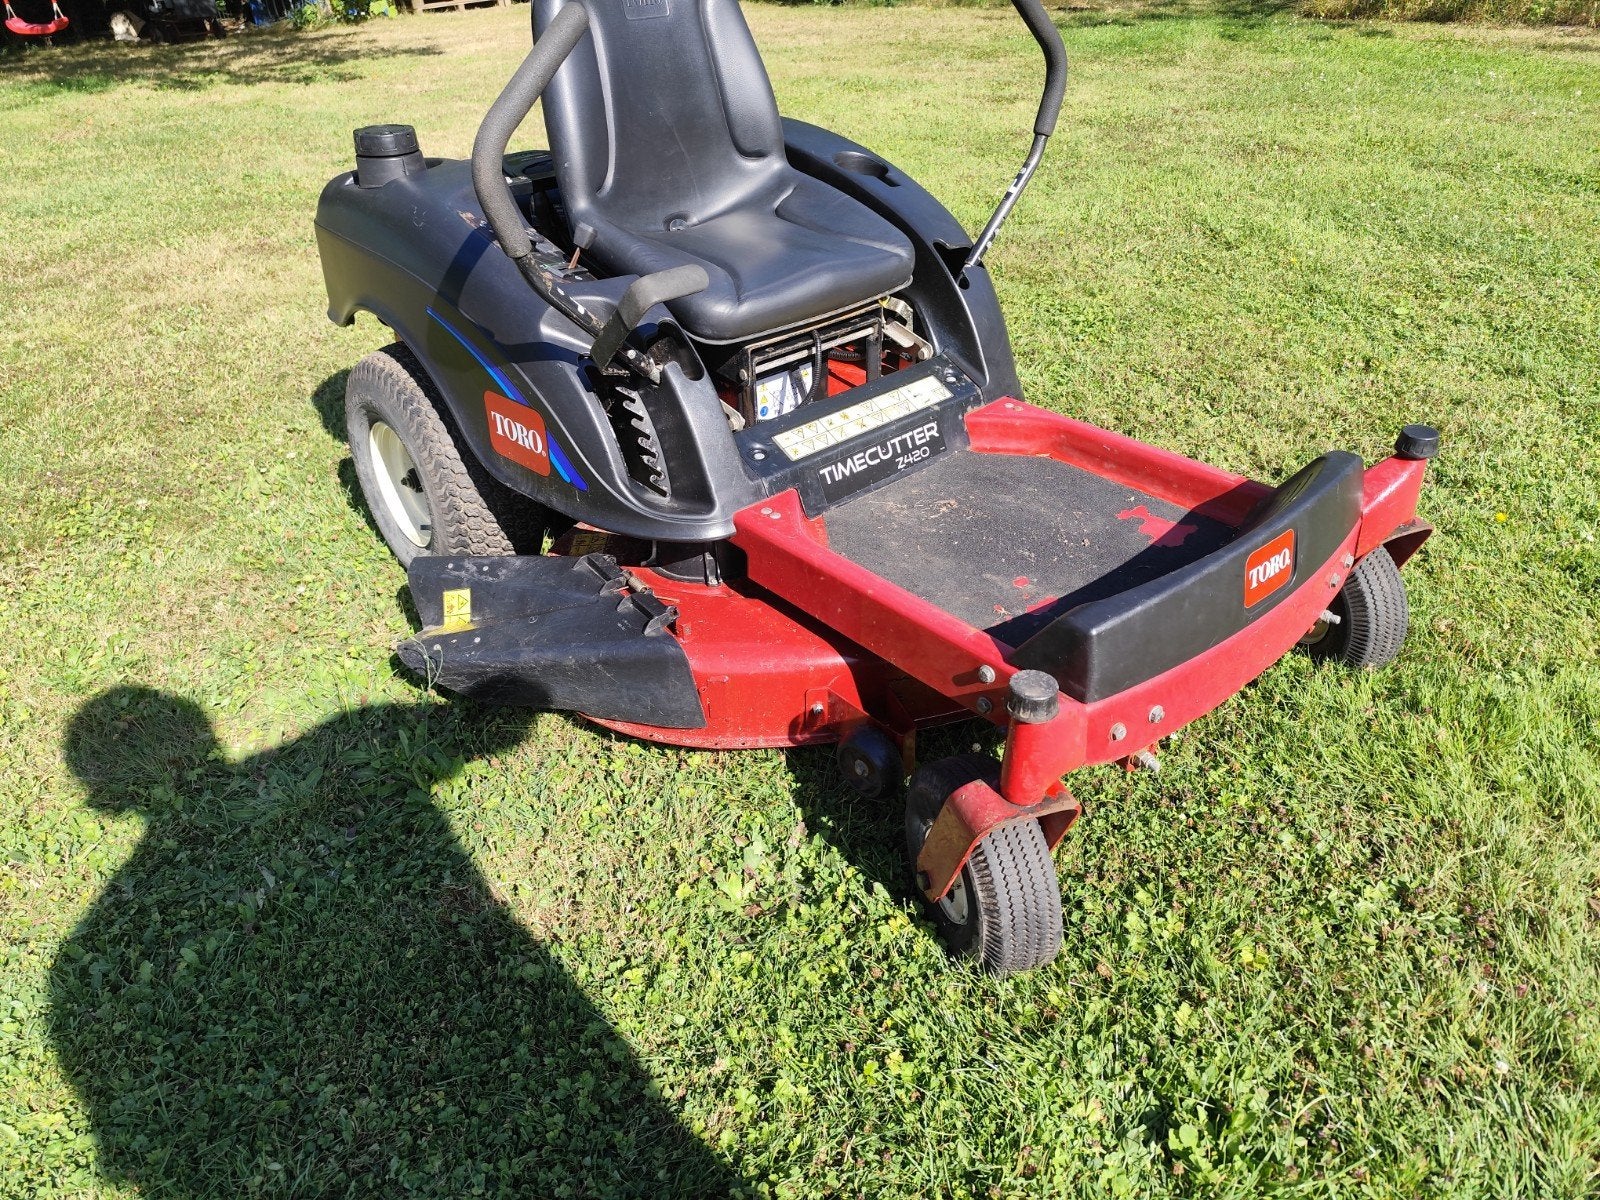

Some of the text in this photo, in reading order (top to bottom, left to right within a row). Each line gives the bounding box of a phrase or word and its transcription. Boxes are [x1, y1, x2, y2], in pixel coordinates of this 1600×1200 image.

[490, 410, 543, 454] TORO
[819, 422, 939, 485] TIMECUTTER
[895, 446, 930, 469] Z420
[1249, 548, 1290, 590] TORO
